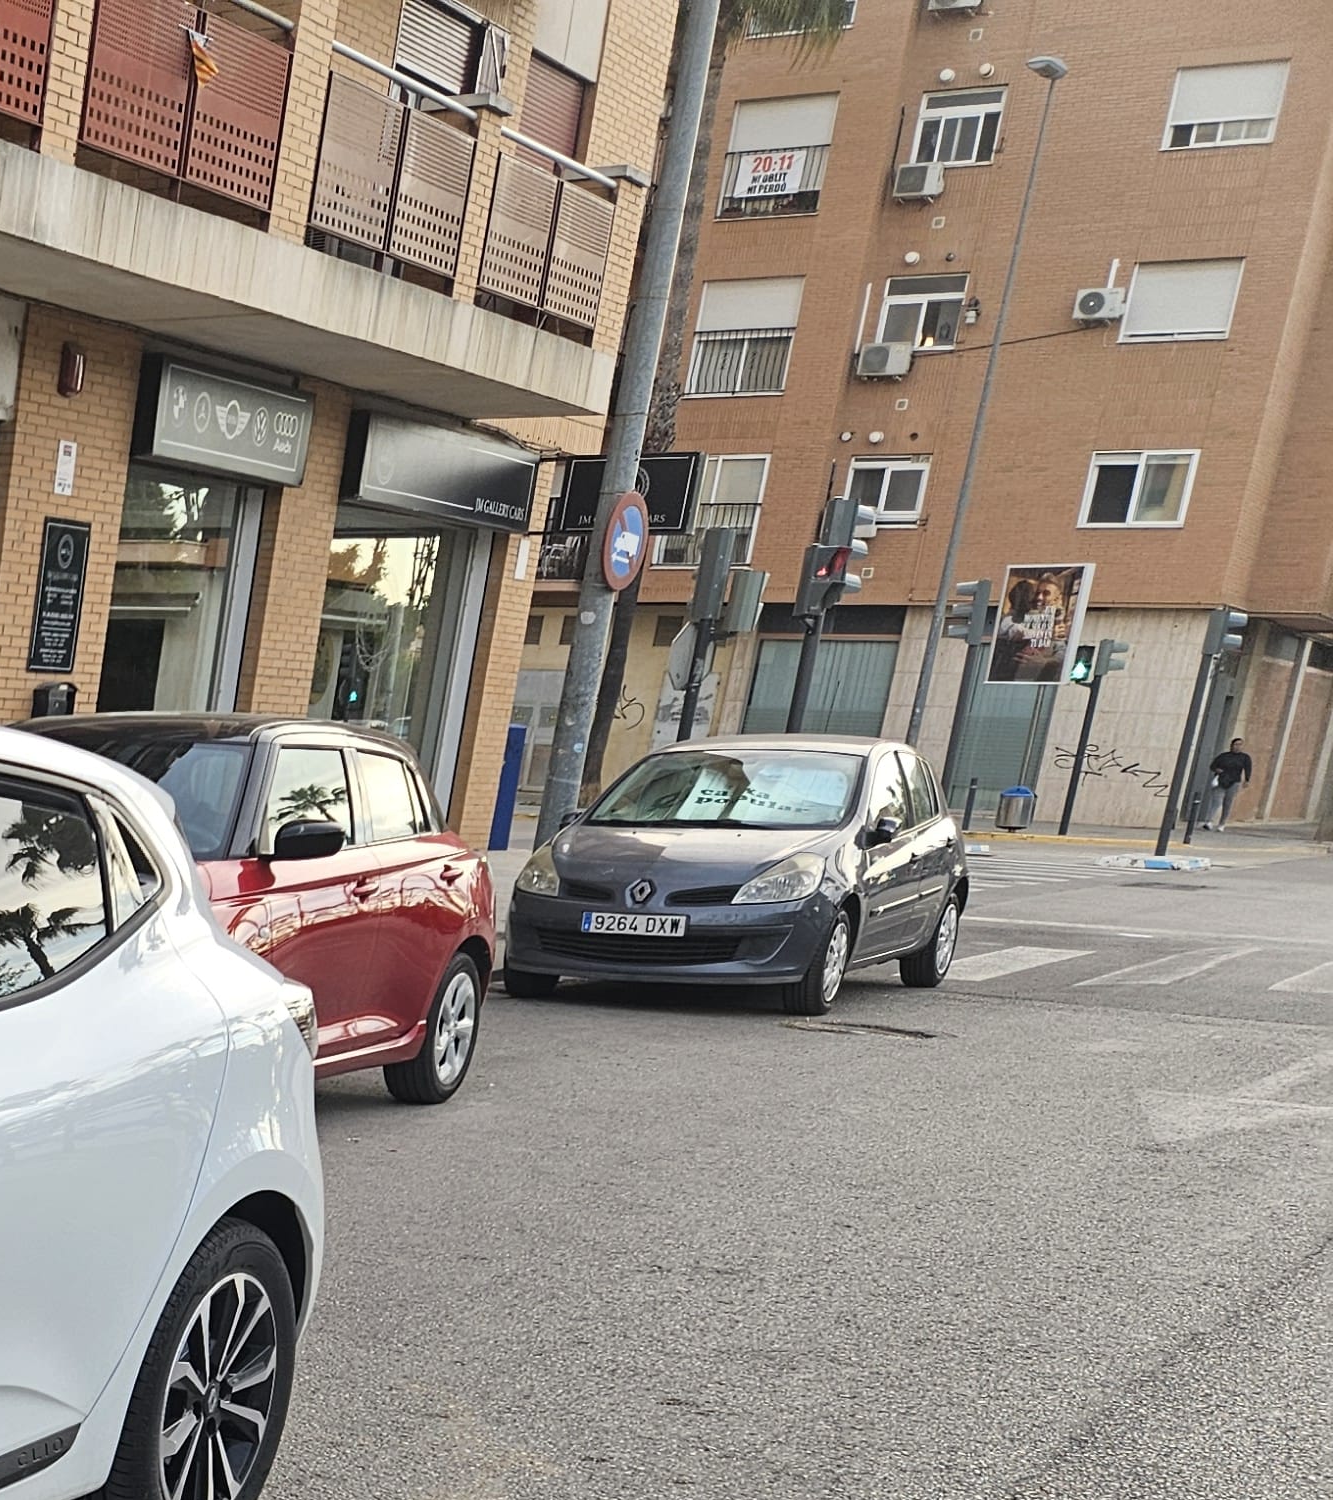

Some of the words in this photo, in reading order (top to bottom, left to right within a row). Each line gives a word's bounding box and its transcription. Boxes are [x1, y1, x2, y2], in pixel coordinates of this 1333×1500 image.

[751, 153, 795, 174] 20:11
[762, 172, 788, 184] OBLIT
[509, 505, 525, 521] CARS
[700, 786, 771, 800] caxa
[594, 915, 638, 933] 9264
[645, 917, 681, 934] DXW
